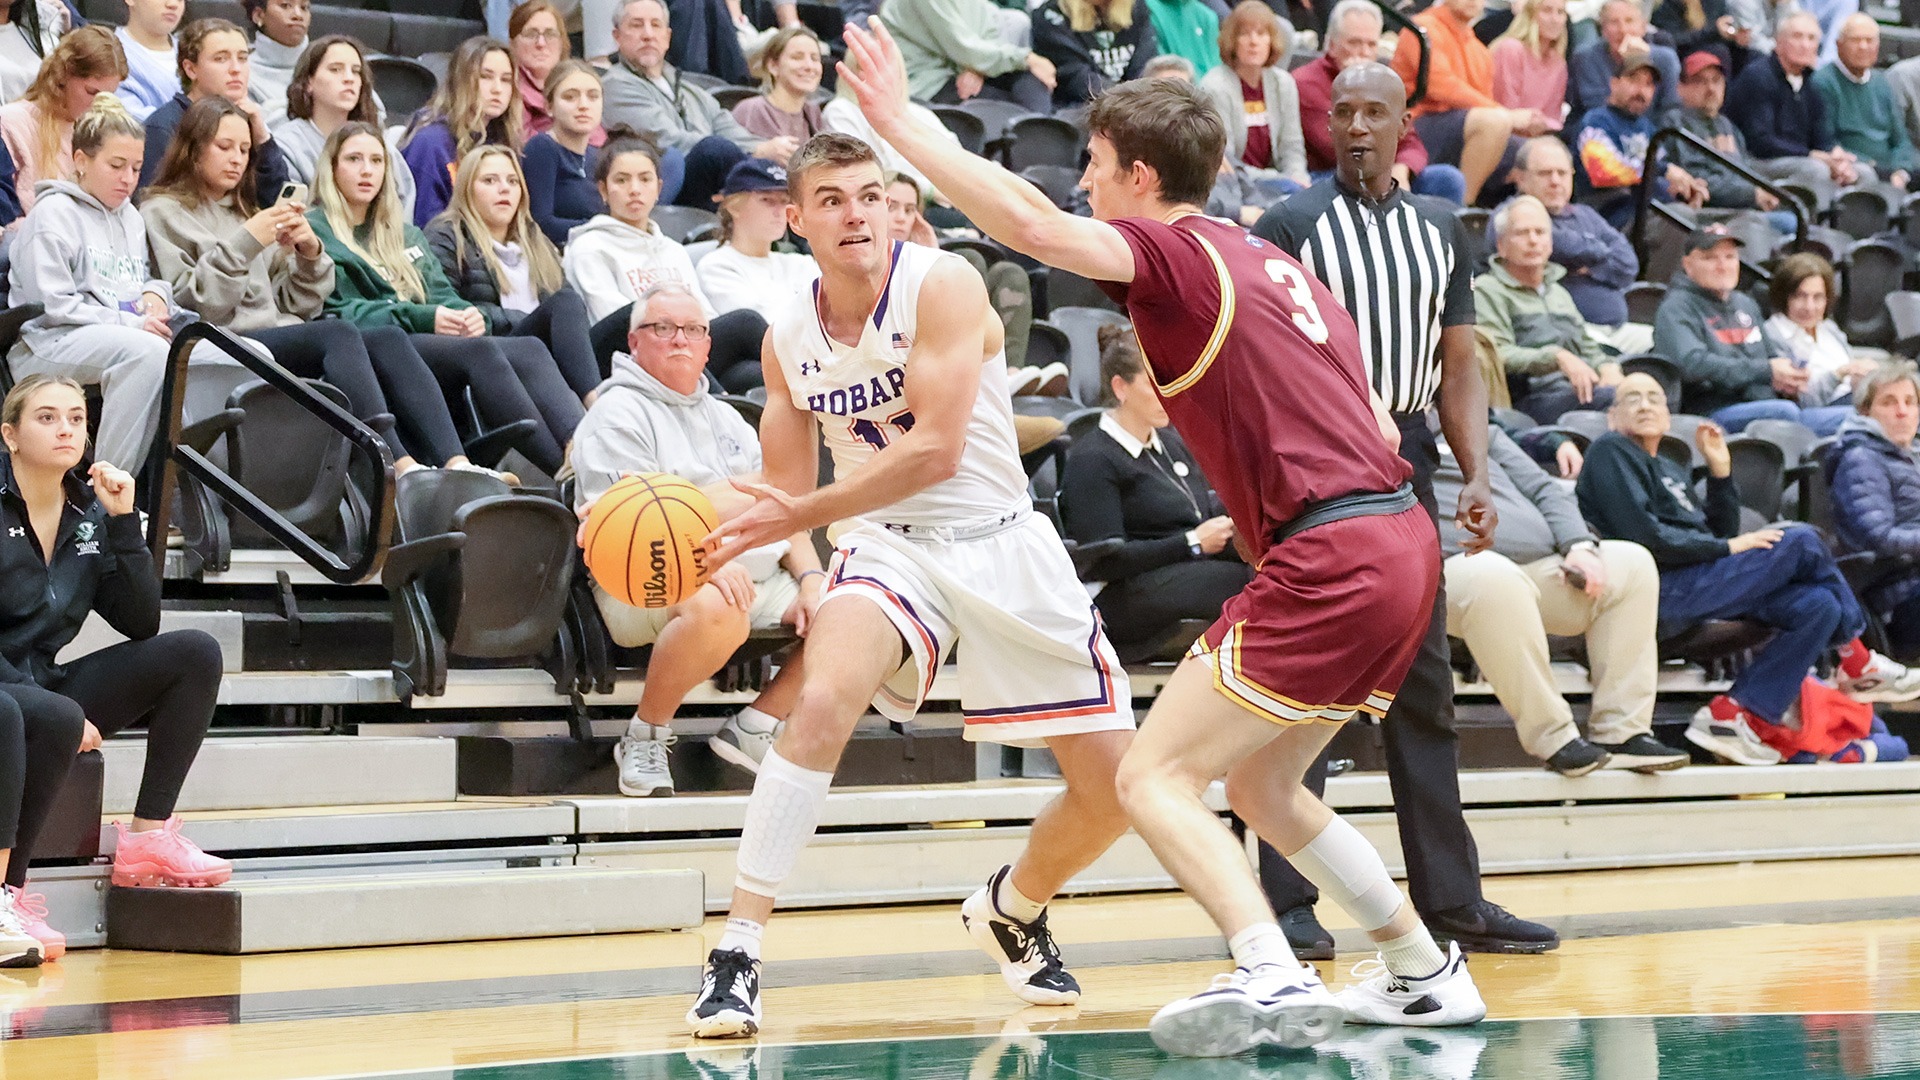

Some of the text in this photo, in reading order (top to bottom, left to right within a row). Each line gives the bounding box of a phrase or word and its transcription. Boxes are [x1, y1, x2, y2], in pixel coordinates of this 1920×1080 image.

[1263, 258, 1329, 345] 3
[807, 365, 906, 416] HOBAR
[846, 408, 916, 453] 1
[643, 539, 668, 609] Wilson
